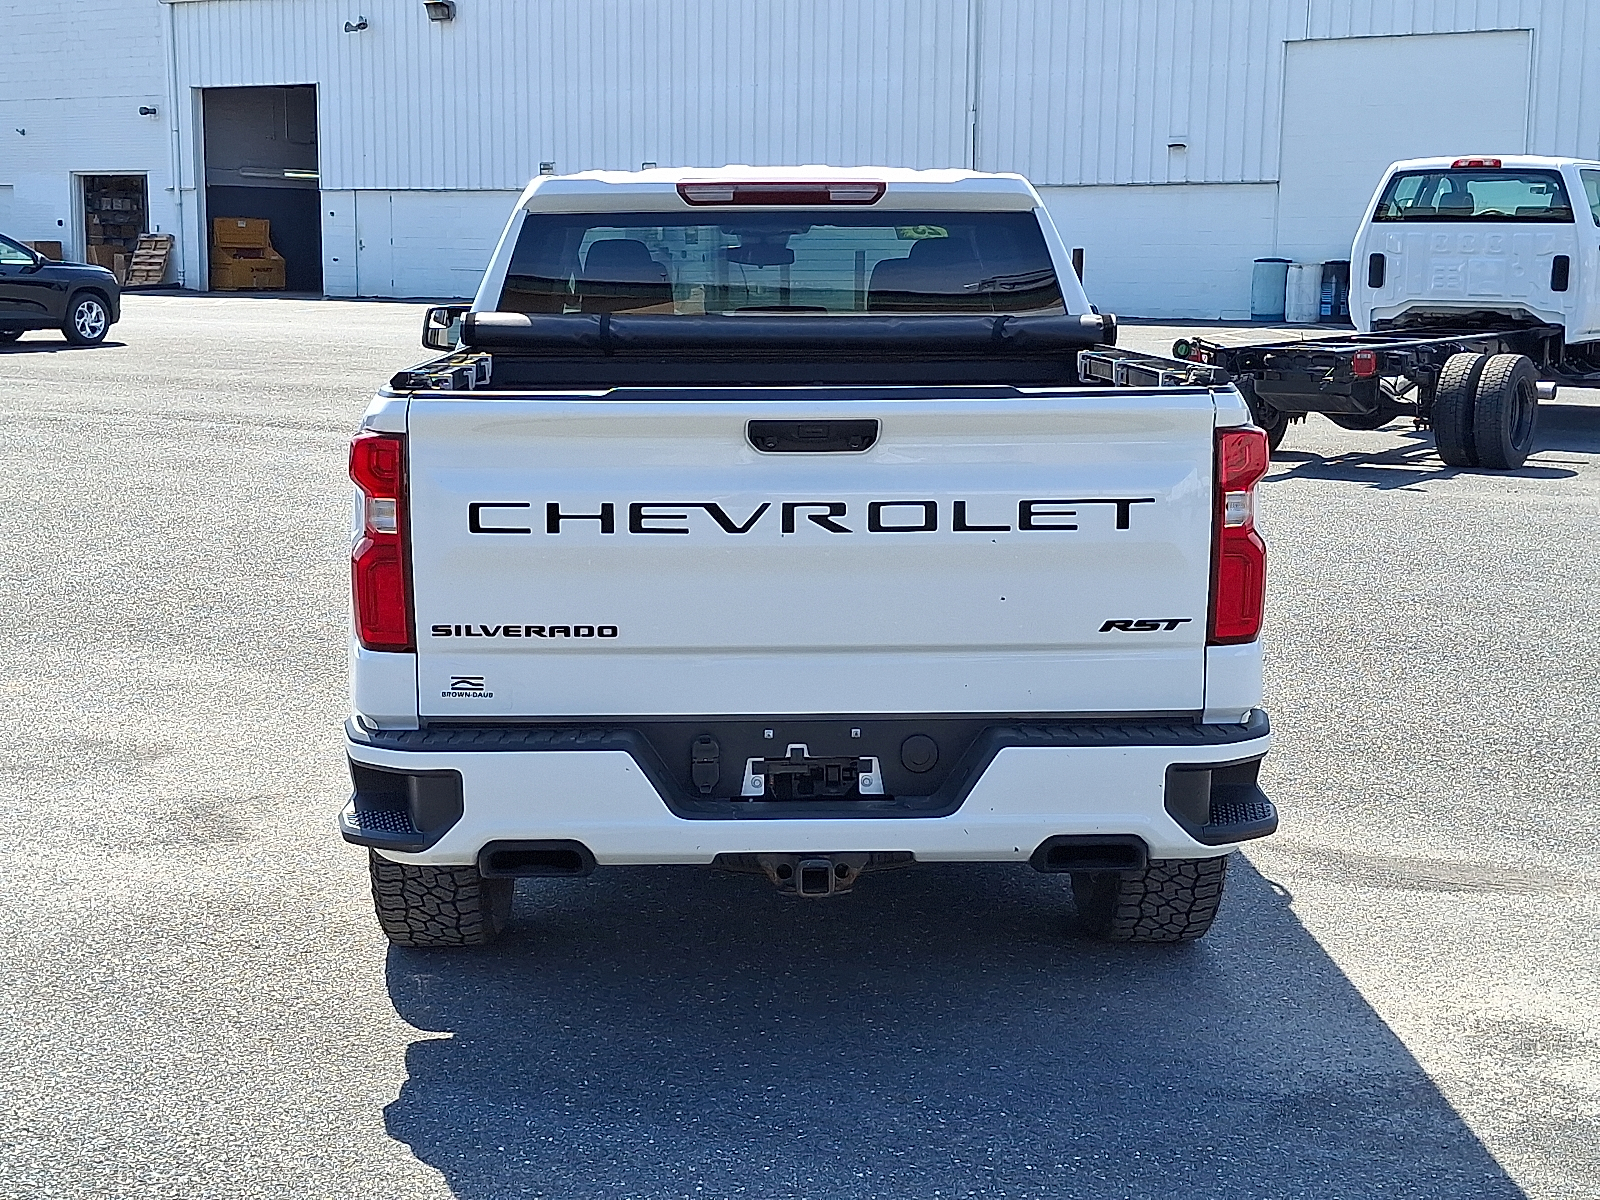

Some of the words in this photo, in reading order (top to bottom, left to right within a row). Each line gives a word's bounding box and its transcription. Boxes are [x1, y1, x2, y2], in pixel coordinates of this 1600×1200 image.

[468, 498, 1156, 534] CHEVROLET
[431, 624, 618, 638] SILVERADO
[1098, 618, 1192, 632] RST
[441, 691, 494, 699] BROWN-DAUB
